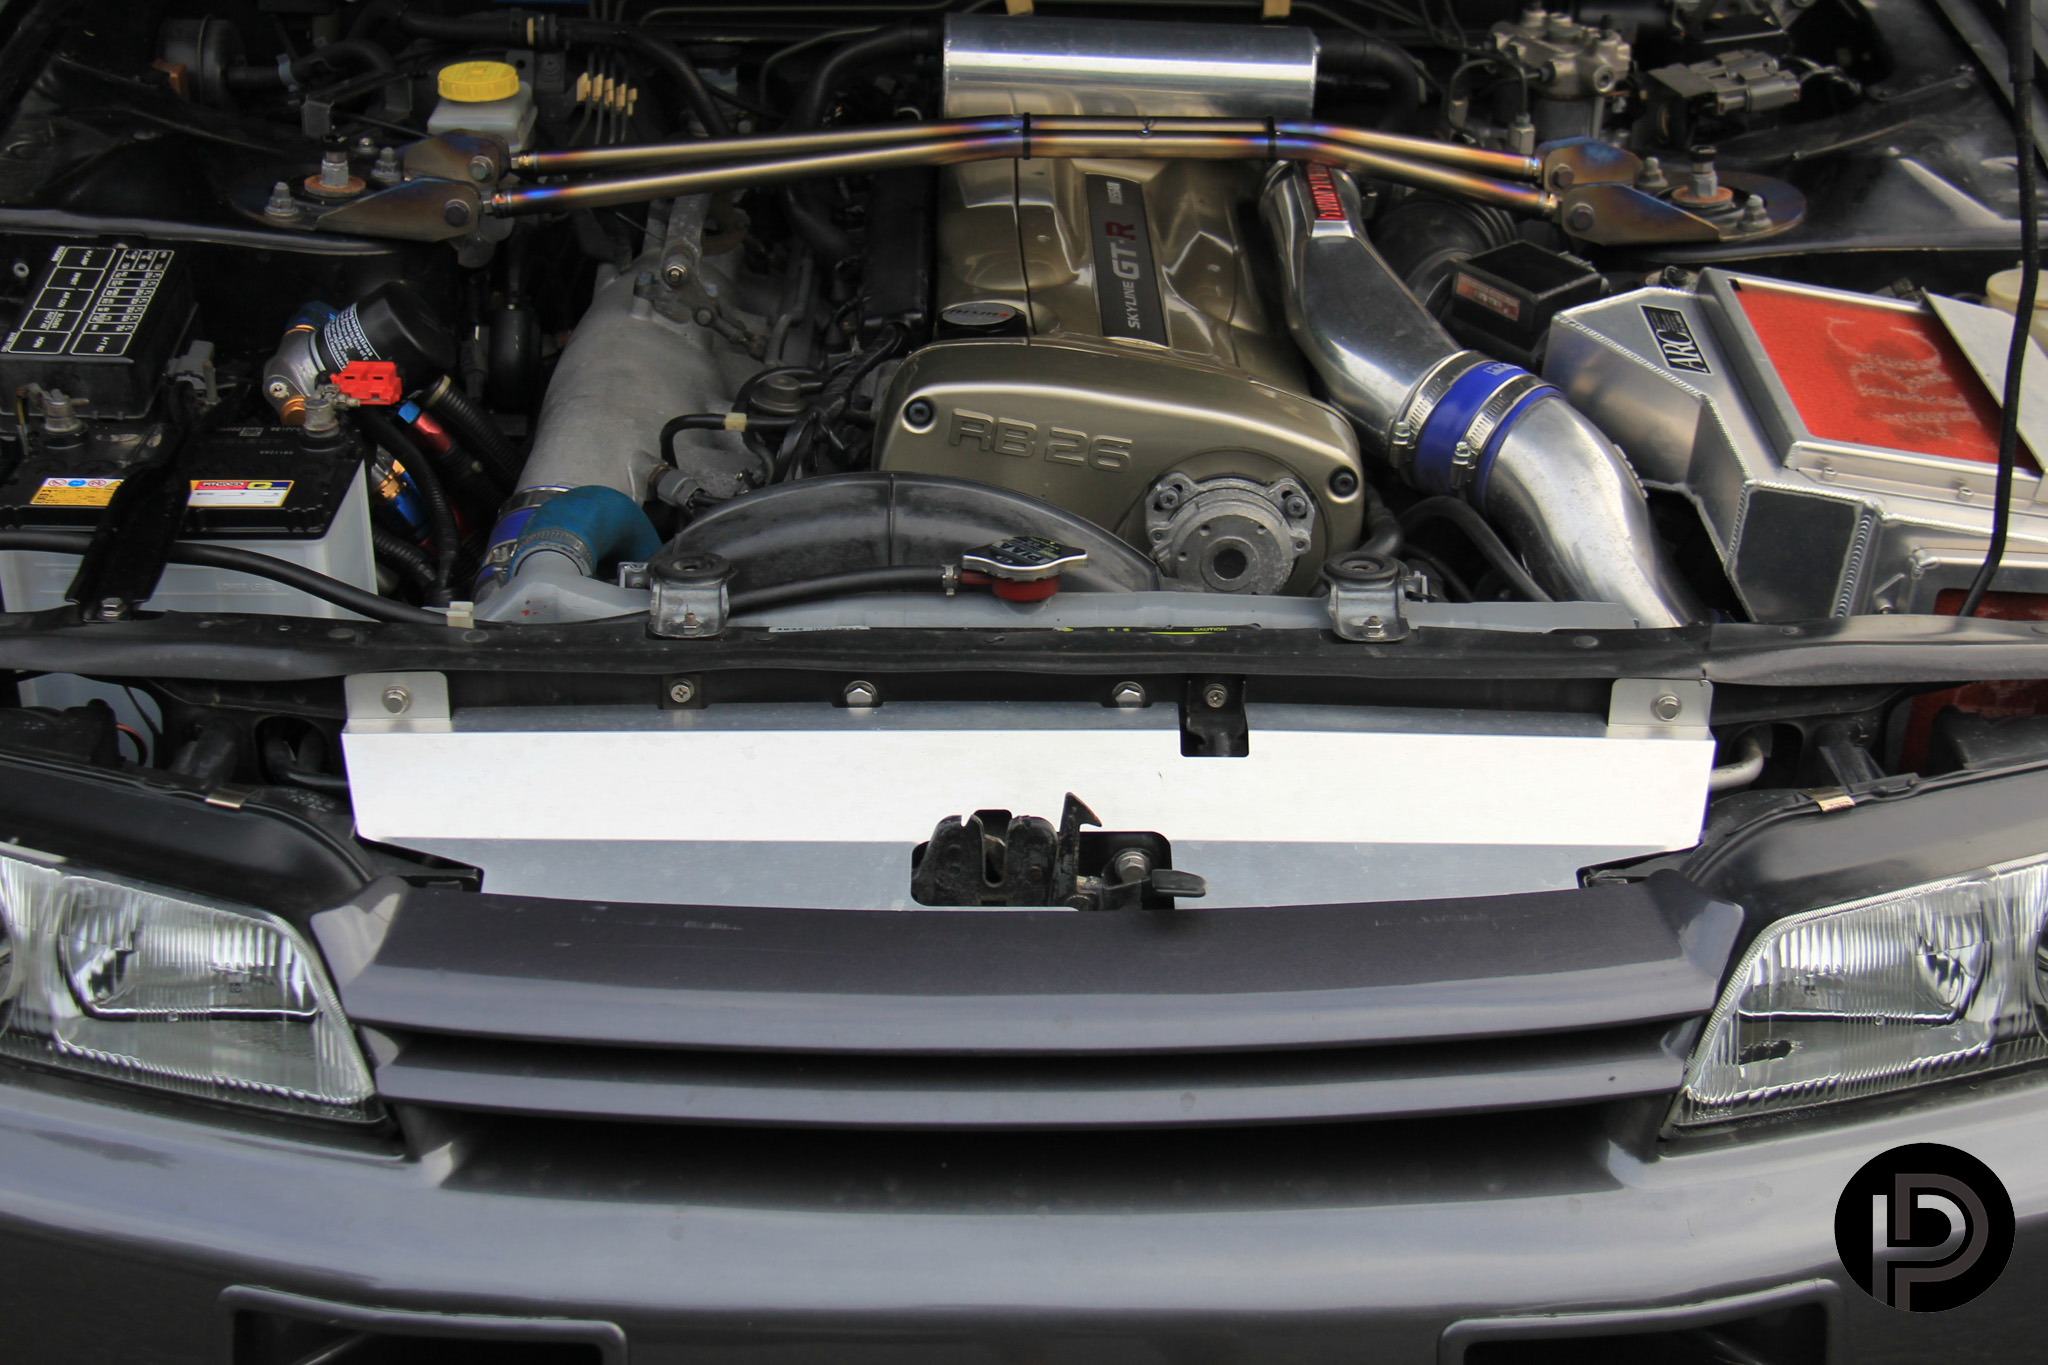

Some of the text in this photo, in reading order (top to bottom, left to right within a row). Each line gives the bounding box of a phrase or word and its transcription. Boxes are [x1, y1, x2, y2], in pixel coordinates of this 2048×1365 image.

[1122, 280, 1141, 329] SKYLINE
[1656, 329, 1708, 373] ARC
[1825, 317, 1999, 451] ARC
[950, 408, 1133, 473] RB 26
